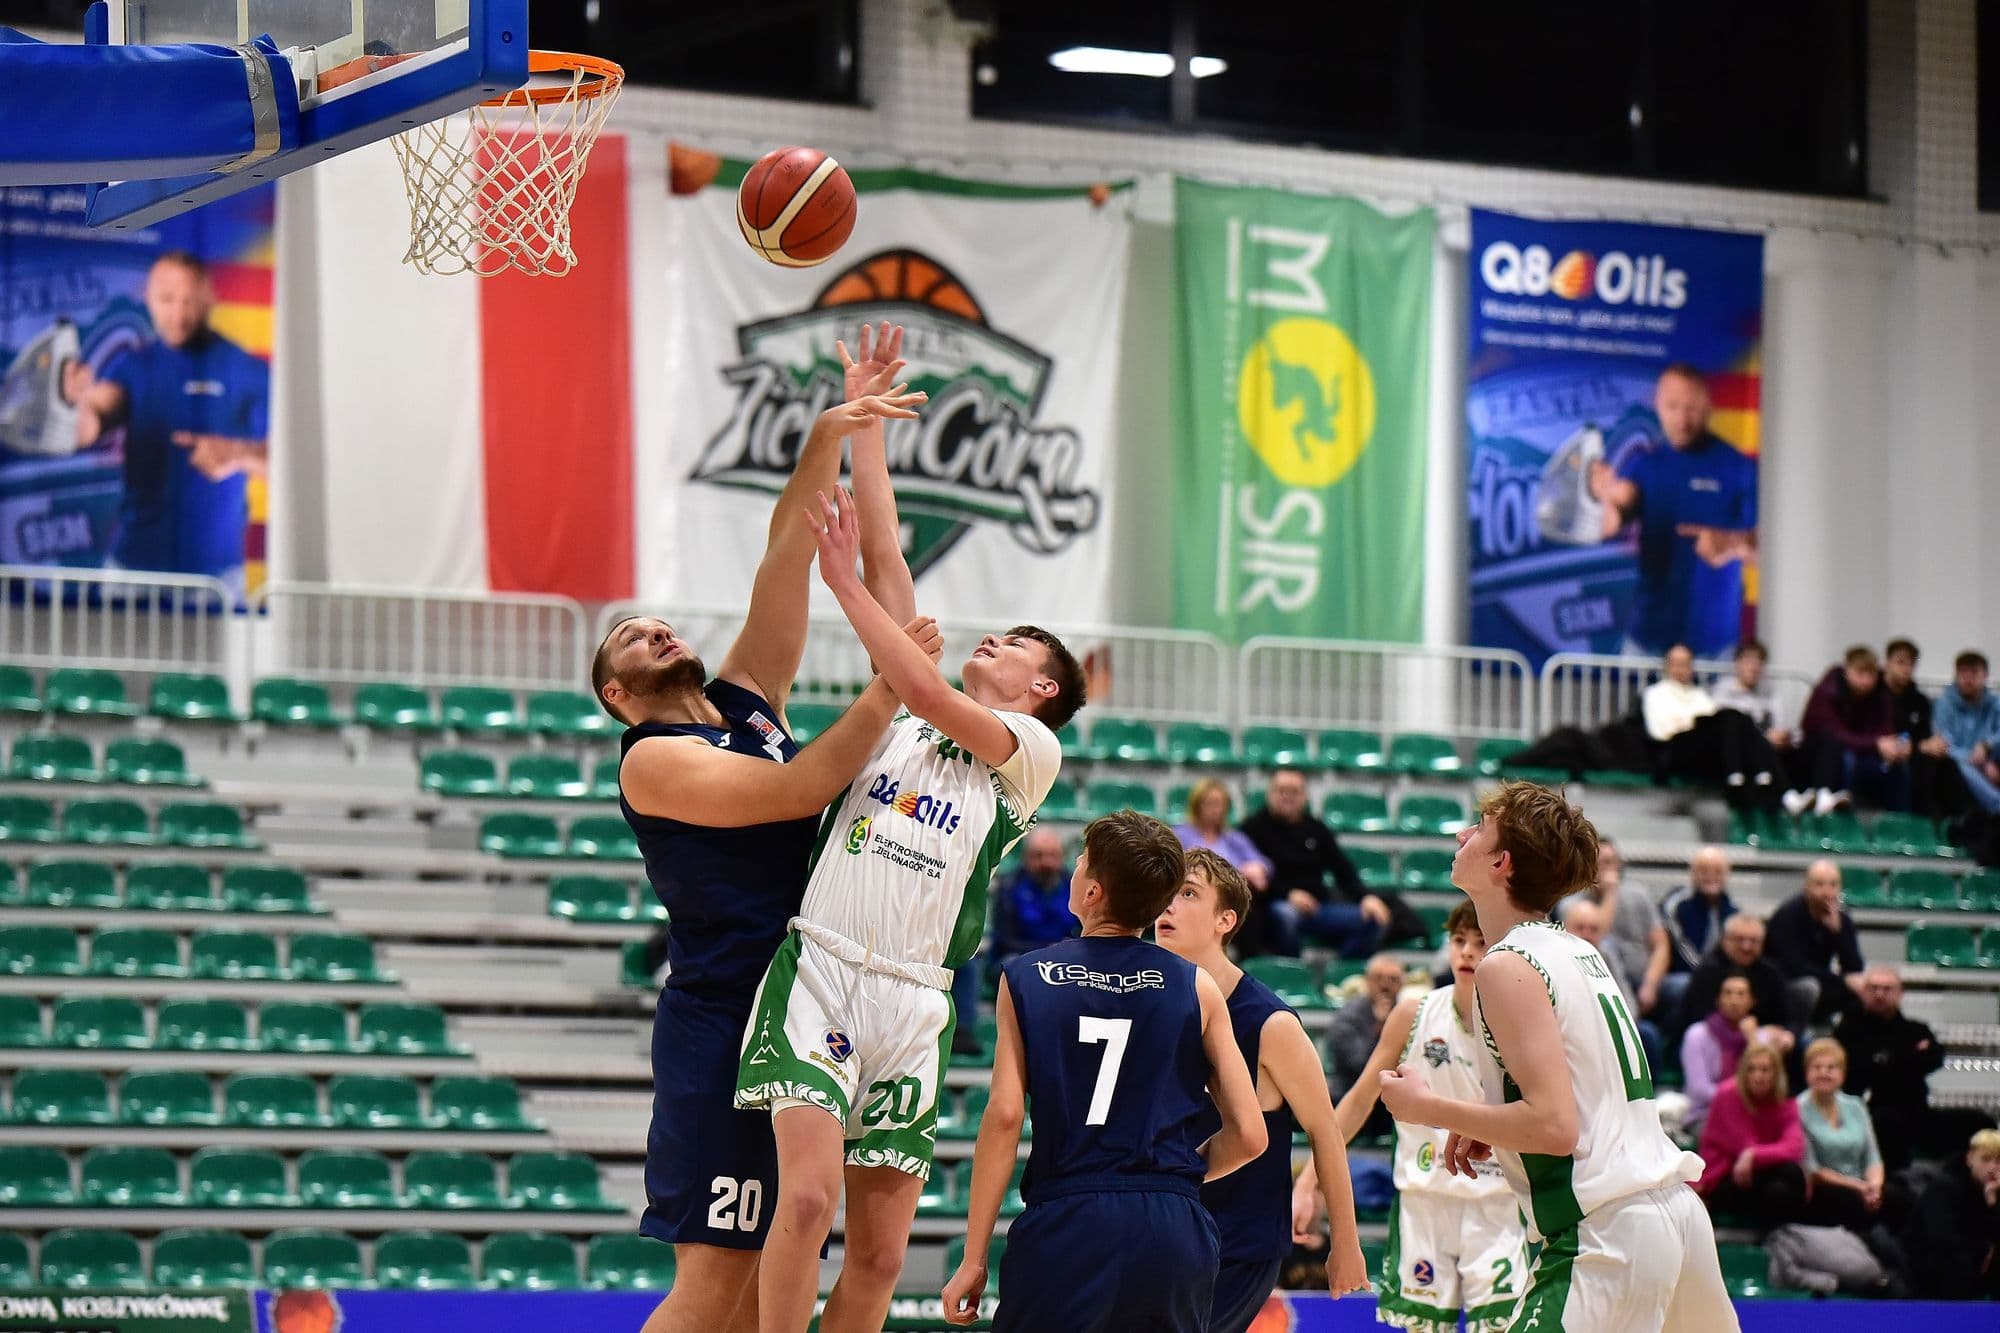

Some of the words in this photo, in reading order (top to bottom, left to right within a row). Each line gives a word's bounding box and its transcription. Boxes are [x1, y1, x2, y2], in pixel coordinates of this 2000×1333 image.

[1481, 240, 1552, 297] Q8
[1594, 251, 1688, 309] Oils
[914, 795, 961, 835] Oils
[1077, 980, 1122, 994] enklawa
[1123, 982, 1165, 993] sportu
[1079, 1015, 1133, 1126] 7
[861, 1076, 922, 1126] 20
[707, 1175, 762, 1232] 20
[1491, 1257, 1513, 1294] 2
